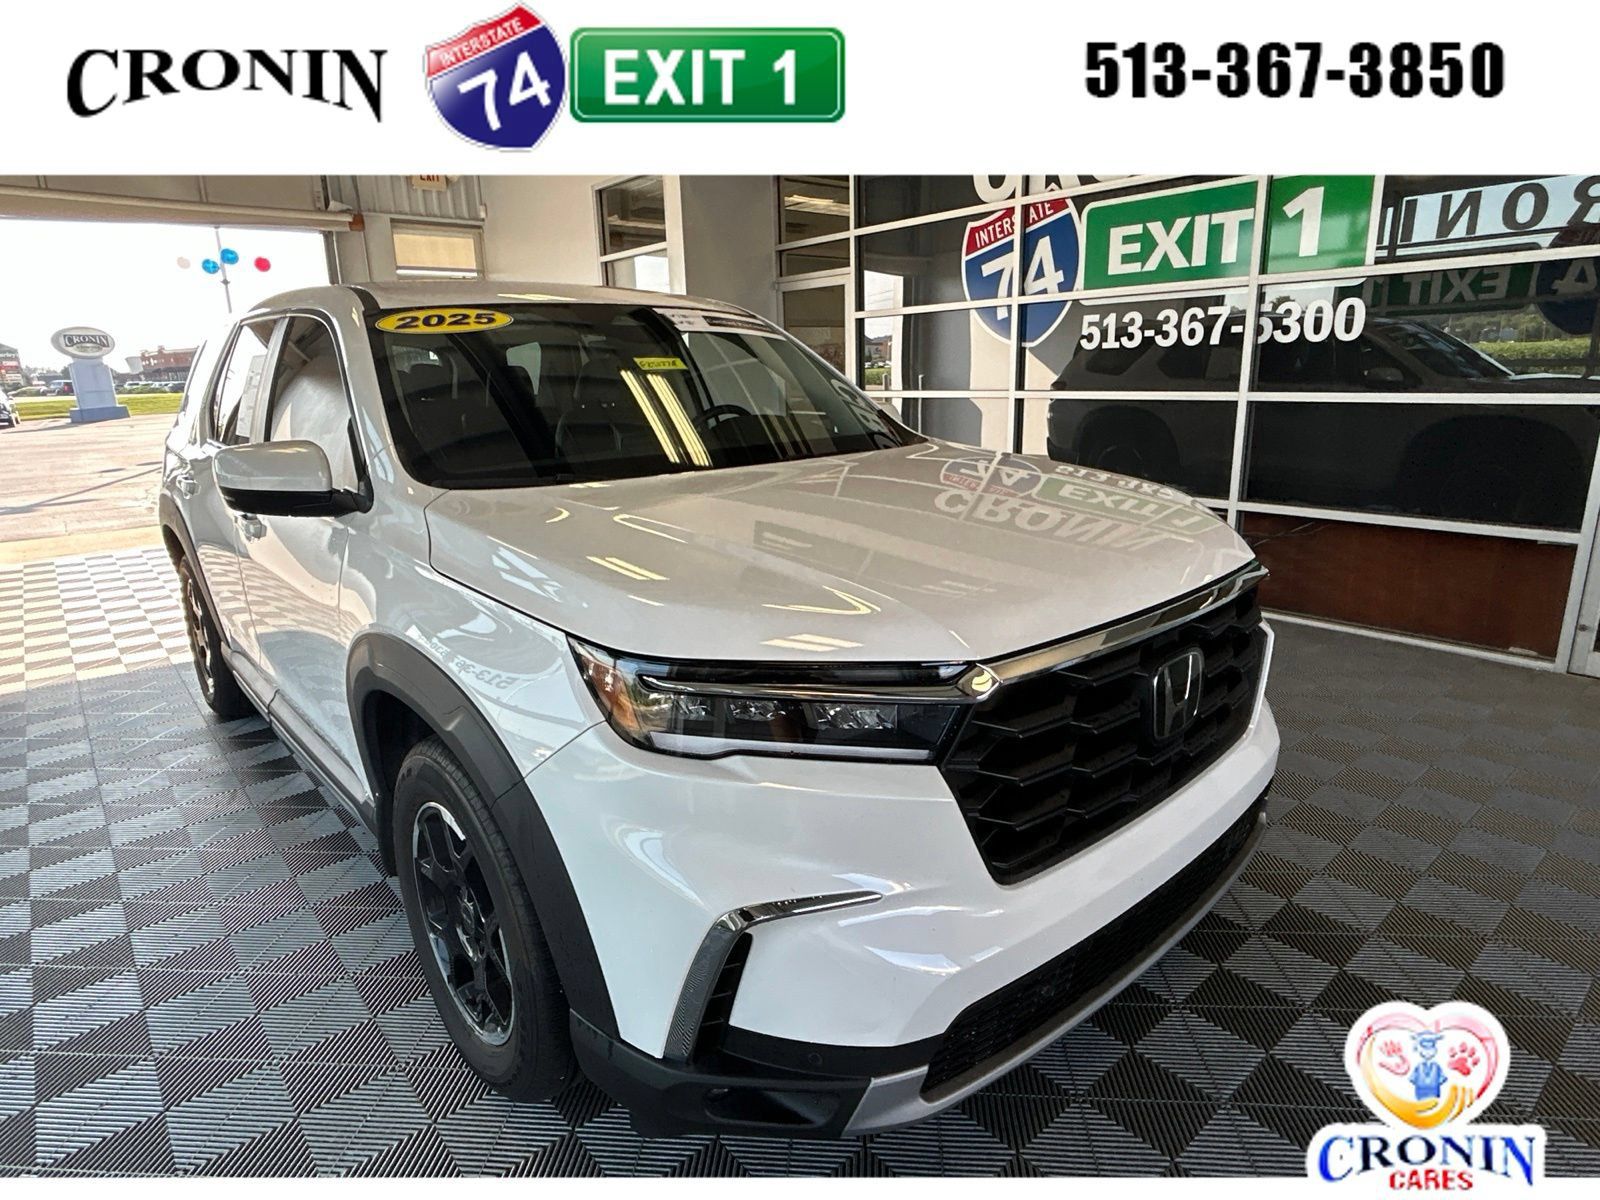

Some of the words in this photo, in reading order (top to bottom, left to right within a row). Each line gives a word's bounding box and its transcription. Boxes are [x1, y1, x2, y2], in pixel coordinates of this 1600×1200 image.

[1107, 207, 1255, 276] EXIT
[1282, 186, 1325, 257] 1
[981, 234, 1065, 321] 74
[63, 335, 110, 347] CRONIN
[394, 312, 496, 330] 2025
